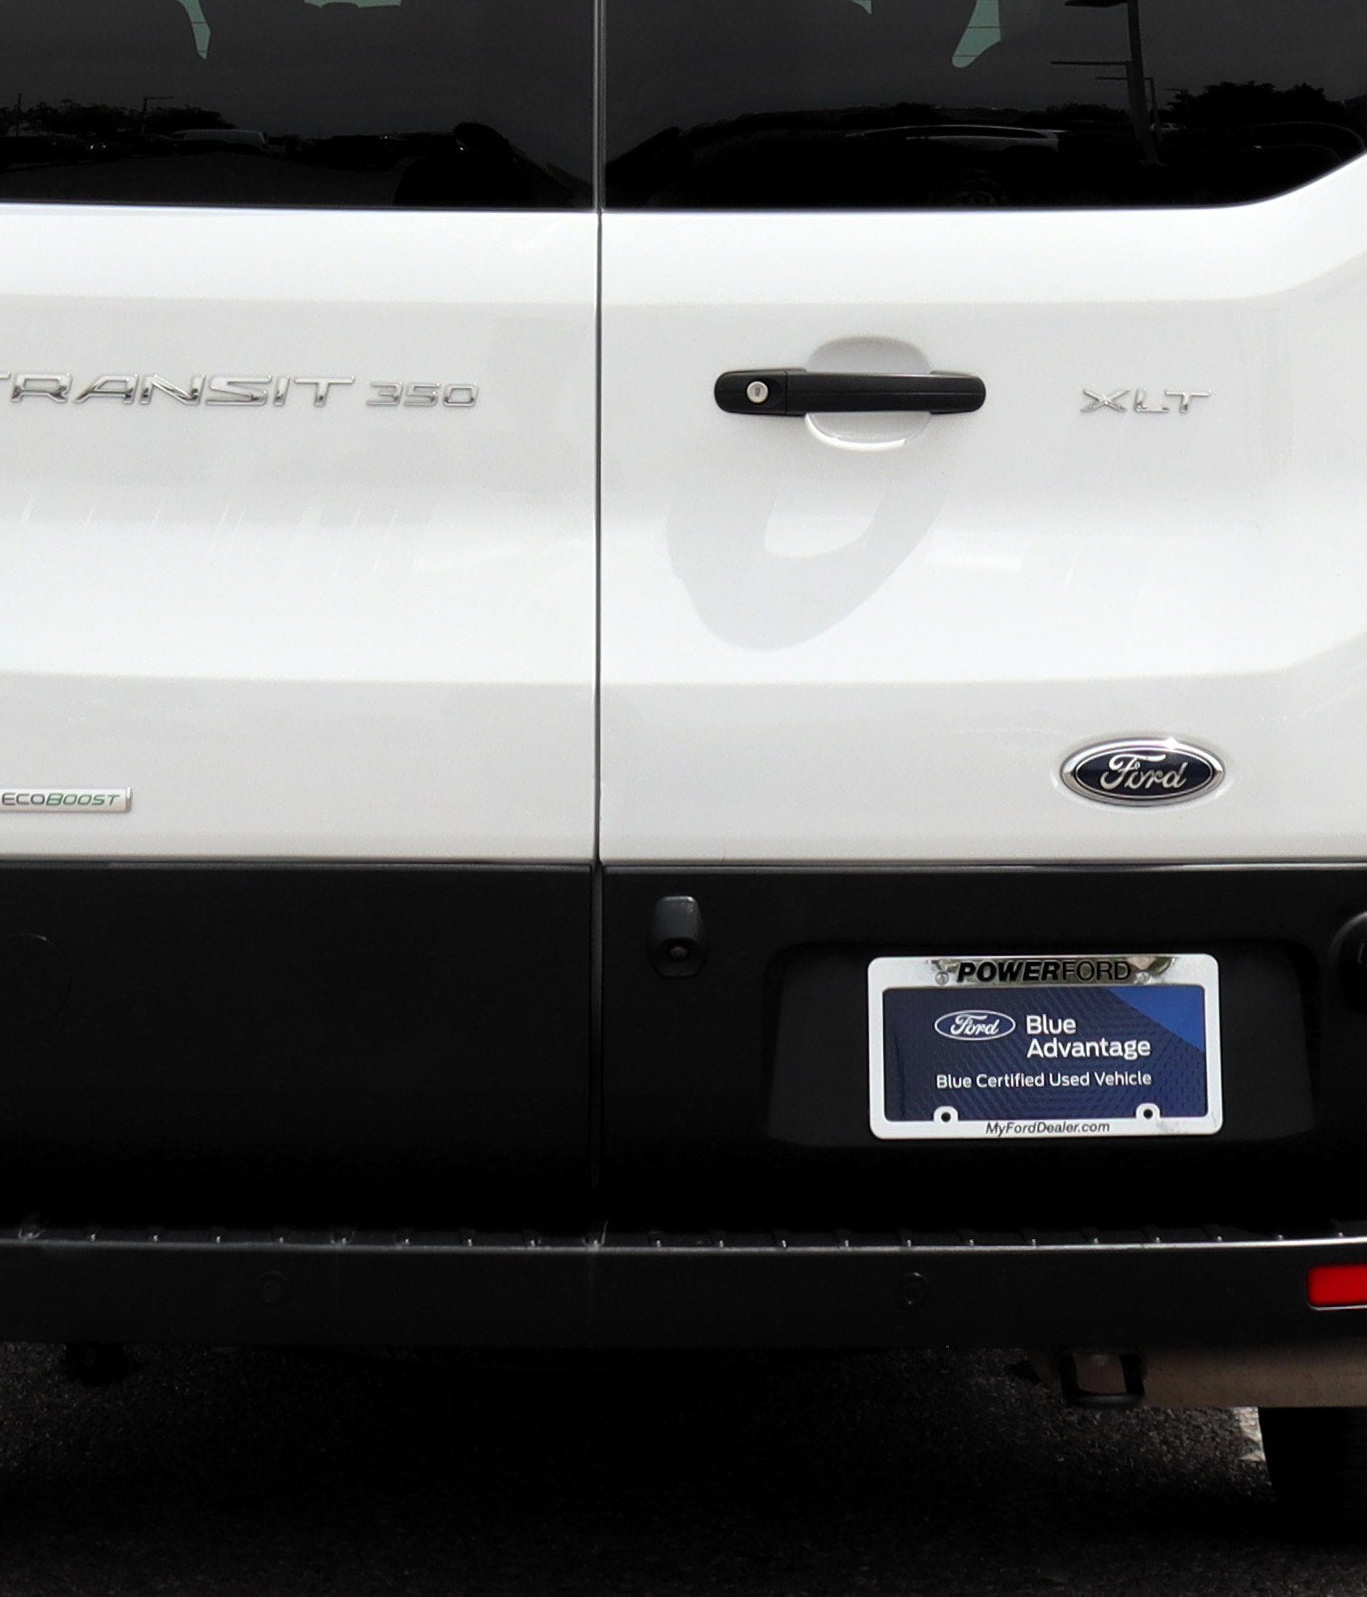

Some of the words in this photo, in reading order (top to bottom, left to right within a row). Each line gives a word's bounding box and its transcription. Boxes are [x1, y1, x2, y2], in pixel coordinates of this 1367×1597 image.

[365, 380, 480, 407] 350
[1080, 387, 1213, 414] XLT
[1100, 753, 1188, 790] Ford
[2, 792, 121, 806] ECOBOOST
[956, 960, 1132, 983] POWERFORD
[949, 1013, 1001, 1036] Ford
[1026, 1014, 1076, 1035] Blue
[1026, 1037, 1152, 1061] Advantage
[936, 1074, 972, 1089] Blue
[975, 1073, 1045, 1088] Certified
[1049, 1072, 1090, 1087] Used
[1094, 1071, 1152, 1086] Vehicle
[985, 1121, 1111, 1139] MyFordDealer.com
